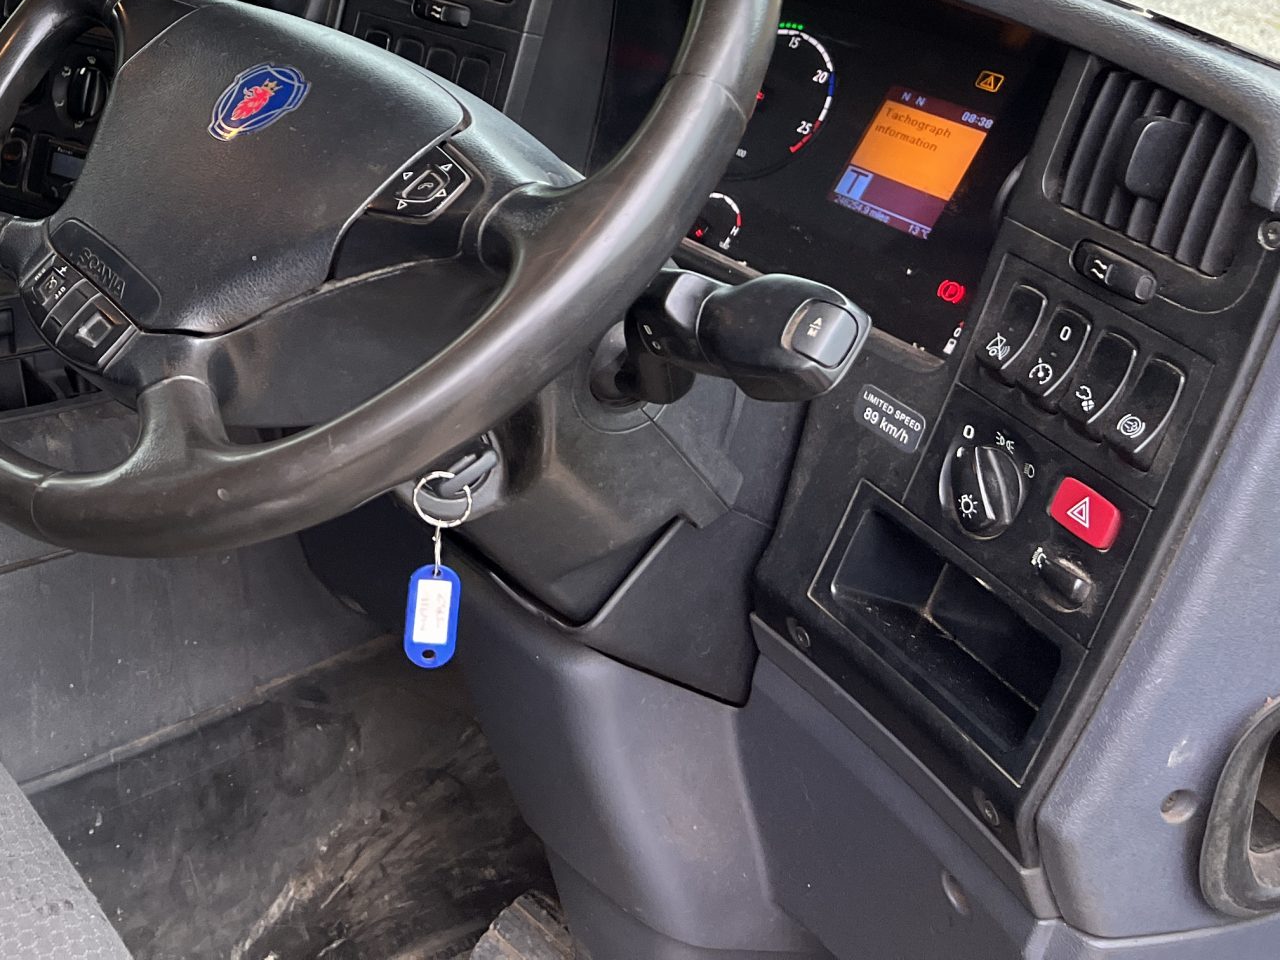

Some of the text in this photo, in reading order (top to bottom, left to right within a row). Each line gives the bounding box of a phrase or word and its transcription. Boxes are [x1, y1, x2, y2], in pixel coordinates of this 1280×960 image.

[789, 36, 801, 49] 15
[812, 69, 829, 84] 20
[796, 121, 812, 135] 25
[885, 107, 952, 138] Tachograph
[875, 124, 938, 152] information
[80, 247, 126, 300] SCANIA
[1060, 326, 1071, 341] 0
[863, 390, 921, 432] LIMITED SPEED
[863, 407, 909, 444] 89 km/h
[963, 424, 975, 439] 0
